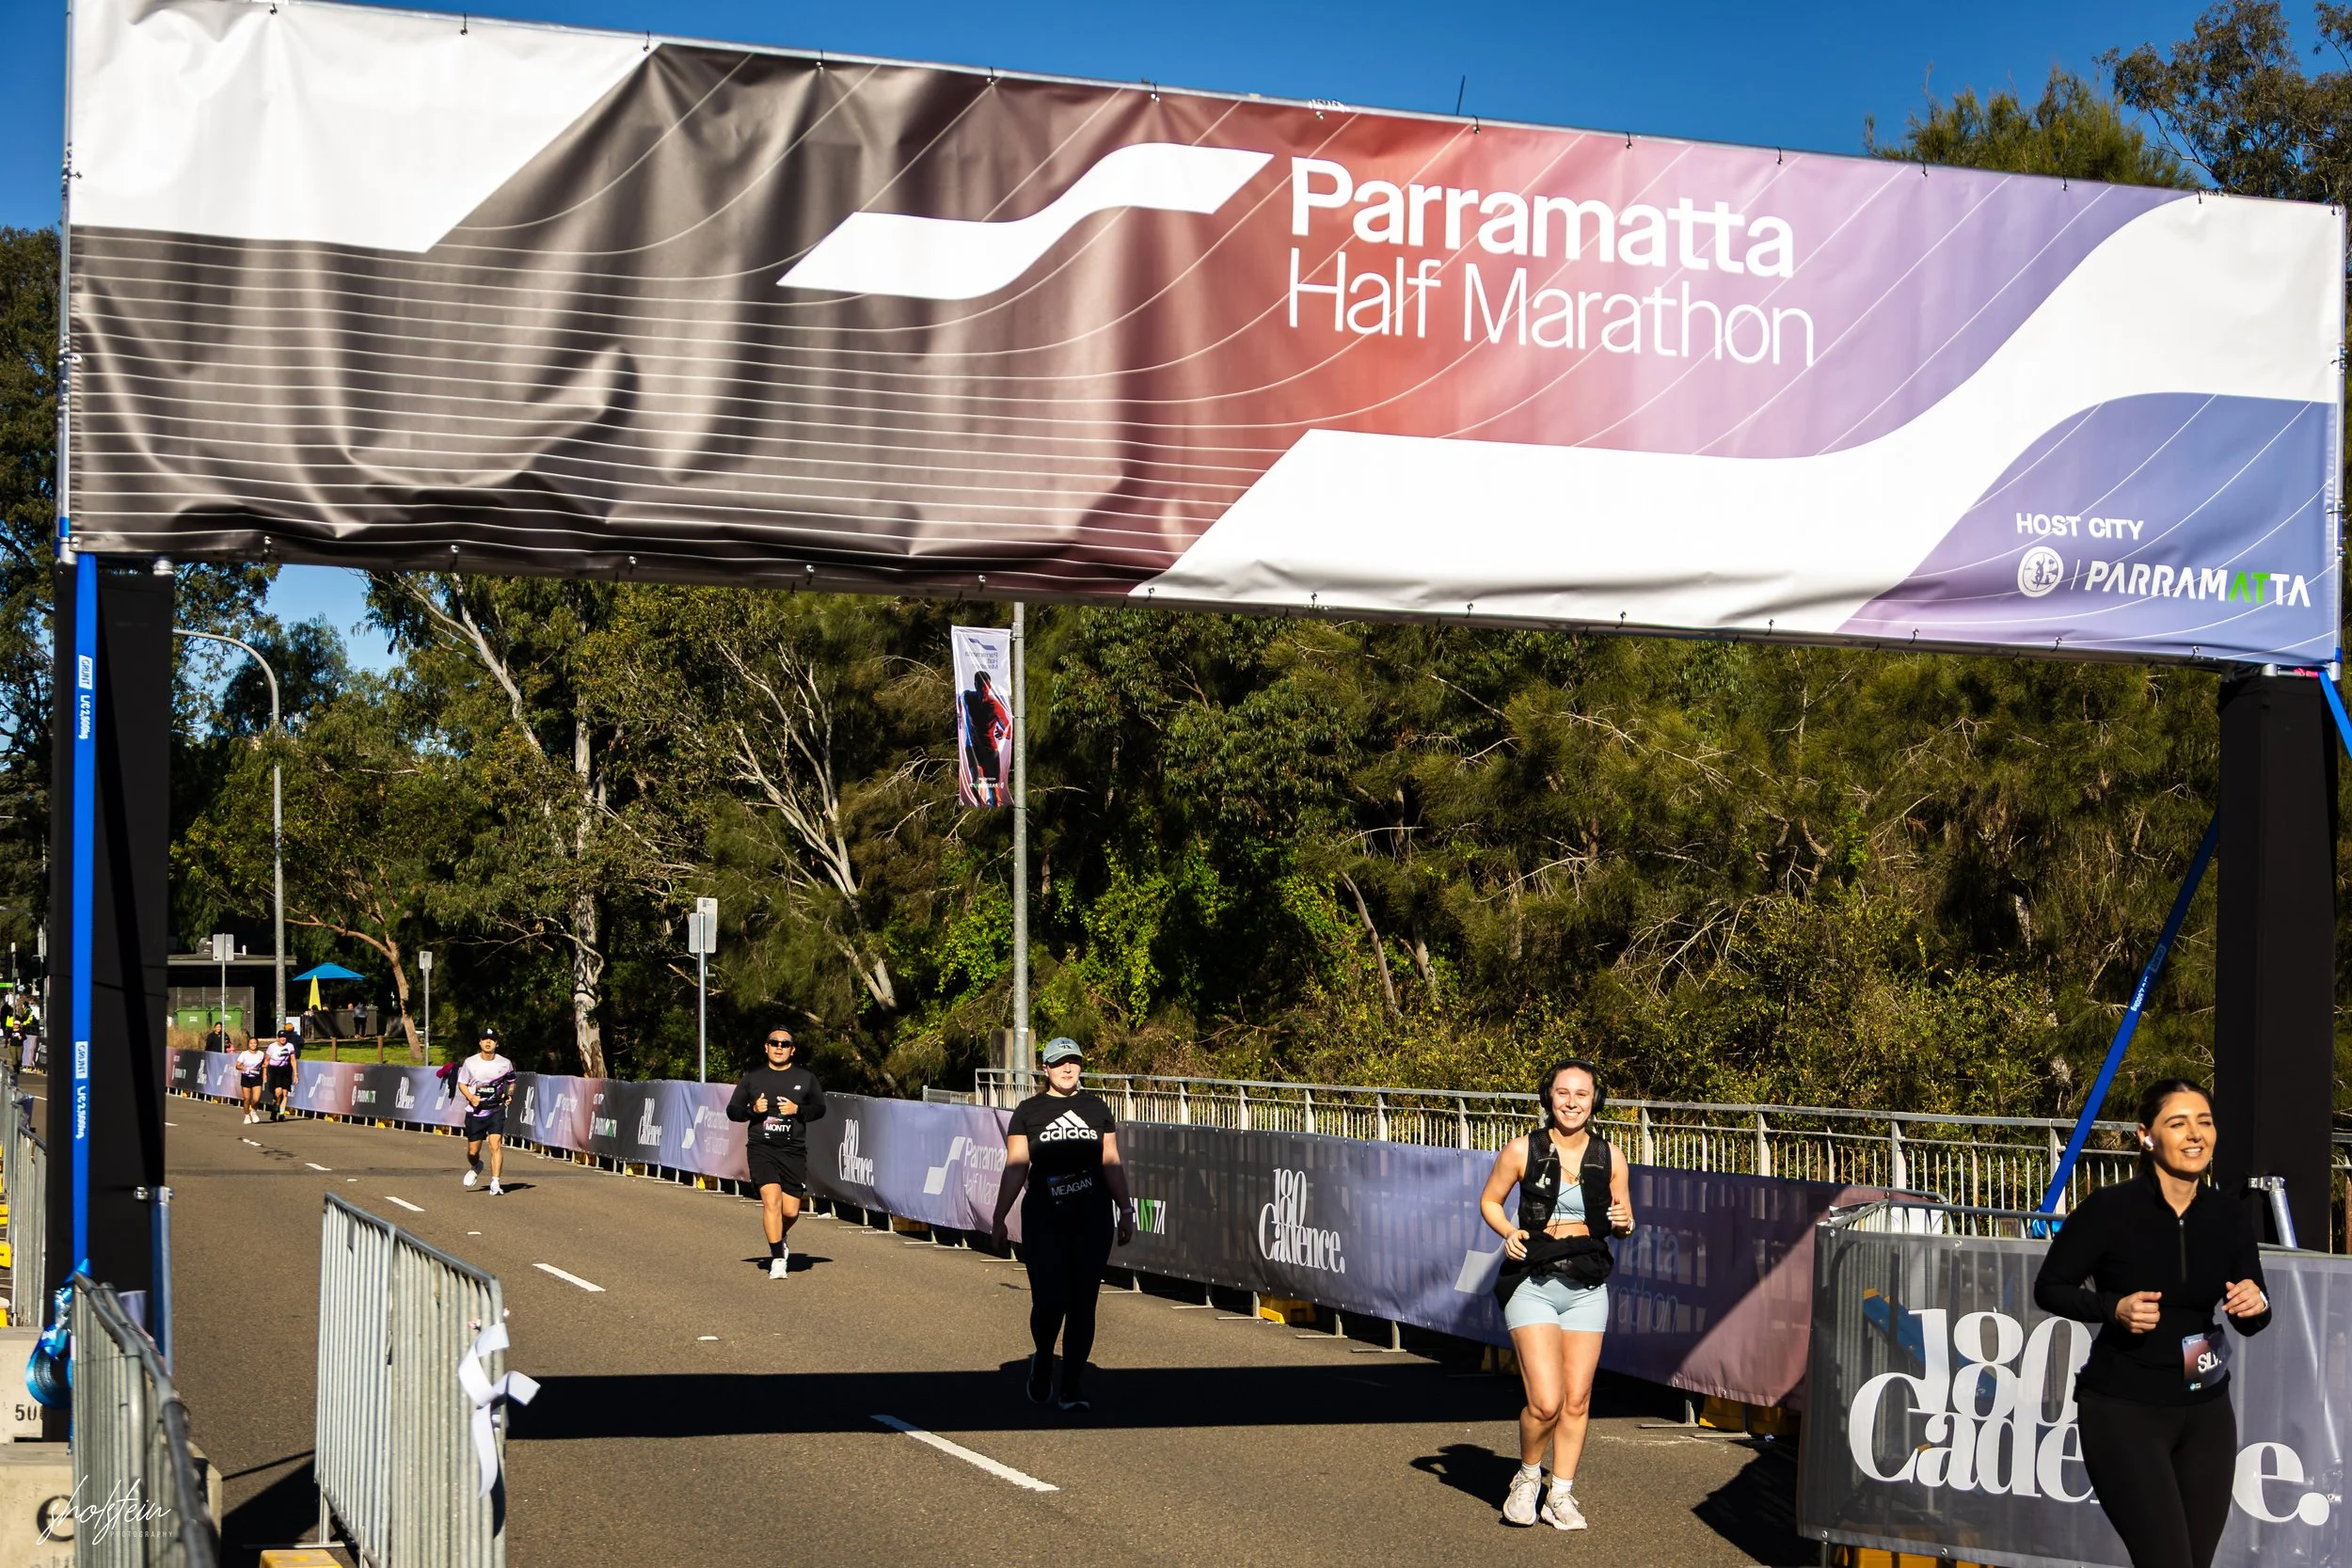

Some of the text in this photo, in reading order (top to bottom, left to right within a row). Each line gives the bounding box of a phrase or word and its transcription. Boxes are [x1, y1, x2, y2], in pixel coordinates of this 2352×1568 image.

[1292, 157, 1794, 277] Parramatta
[1289, 247, 1814, 367] Half Marathon
[2016, 513, 2144, 540] HOST CITY
[2085, 560, 2311, 607] PARRAMATTA
[765, 1123, 791, 1132] MONTY
[1040, 1126, 1098, 1142] adidas
[964, 1137, 1008, 1172] Parrama
[1051, 1178, 1092, 1196] MEAGAN
[1273, 1167, 1307, 1227] 180
[2197, 1352, 2222, 1373] SILV
[15, 1403, 43, 1421] 50
[1849, 1372, 2330, 1527] Cadee.
